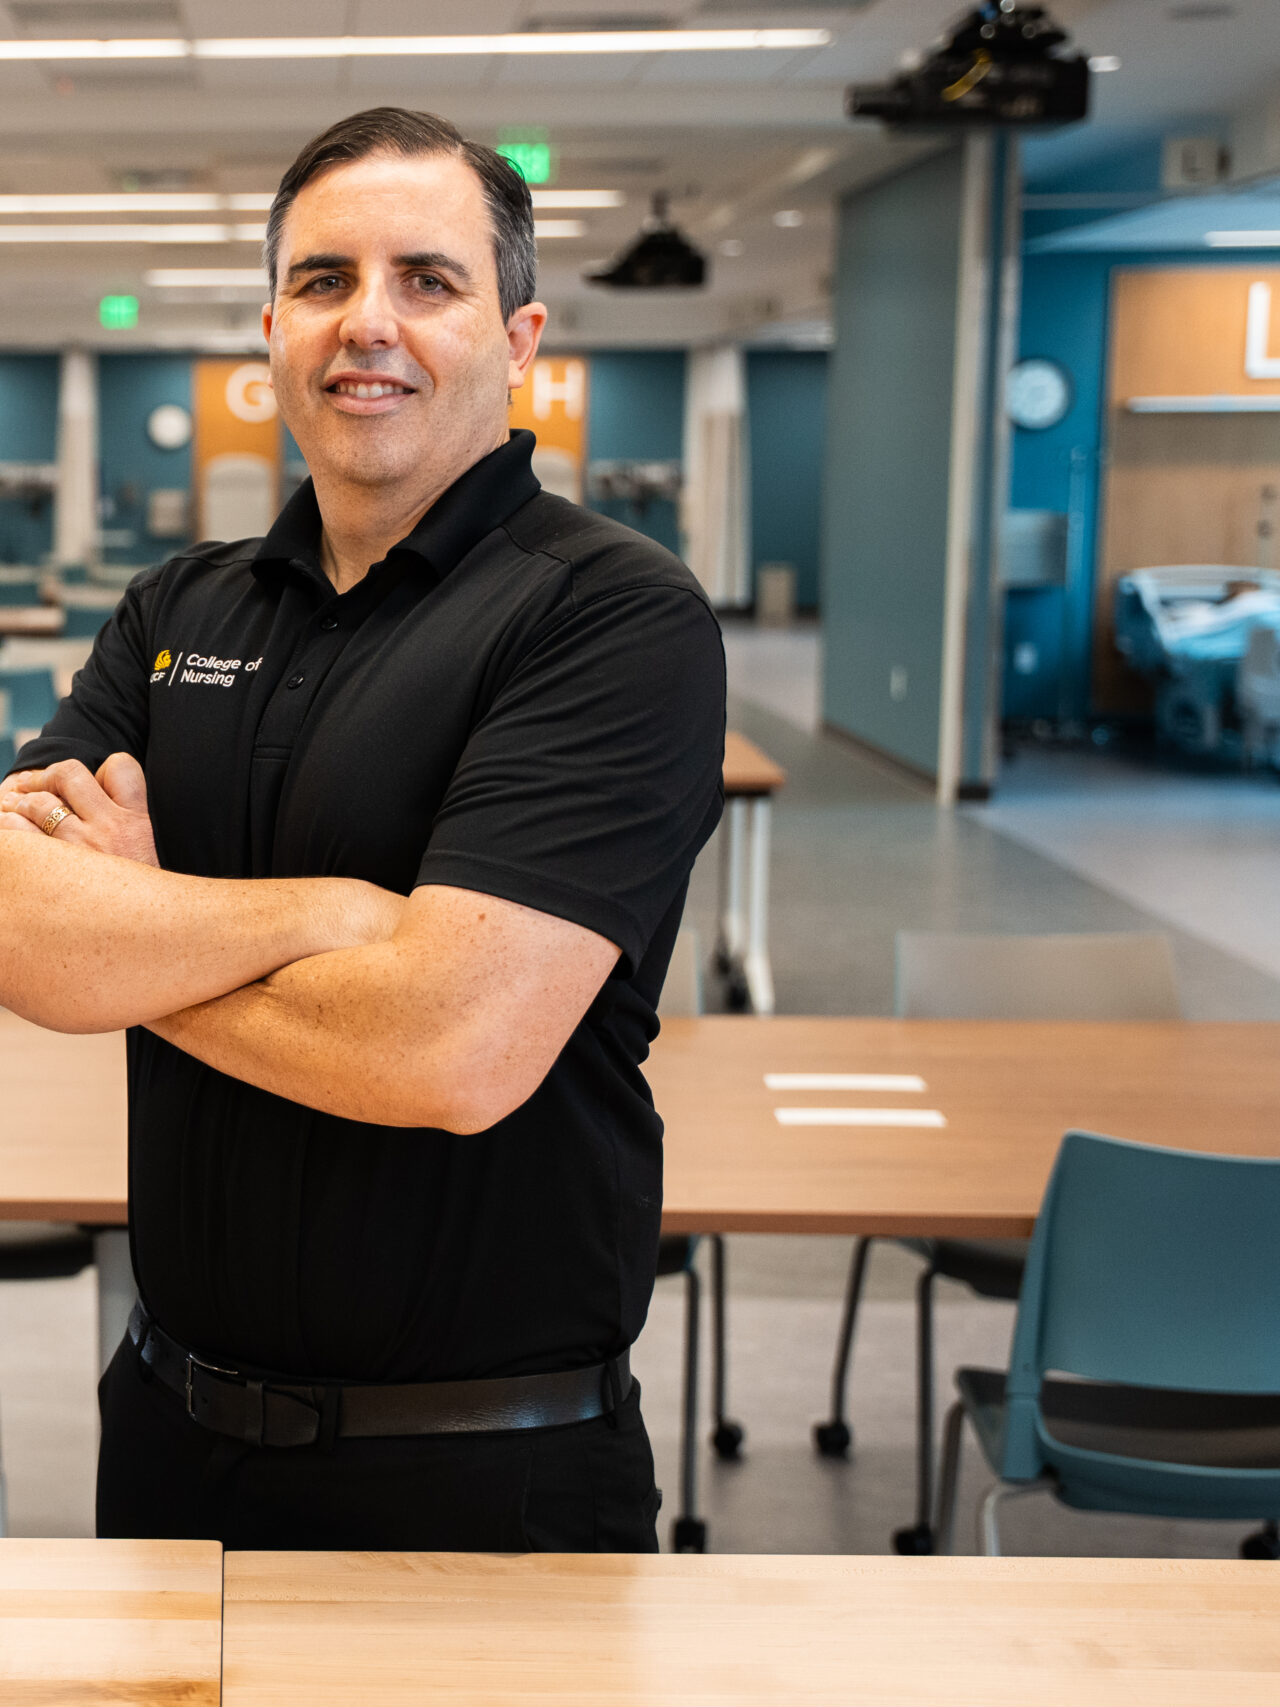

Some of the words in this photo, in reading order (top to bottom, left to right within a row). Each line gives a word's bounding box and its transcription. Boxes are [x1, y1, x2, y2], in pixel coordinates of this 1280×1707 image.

[225, 363, 278, 422] G
[533, 361, 584, 420] H
[180, 669, 236, 687] Nursing
[186, 653, 242, 671] College
[244, 656, 263, 672] of
